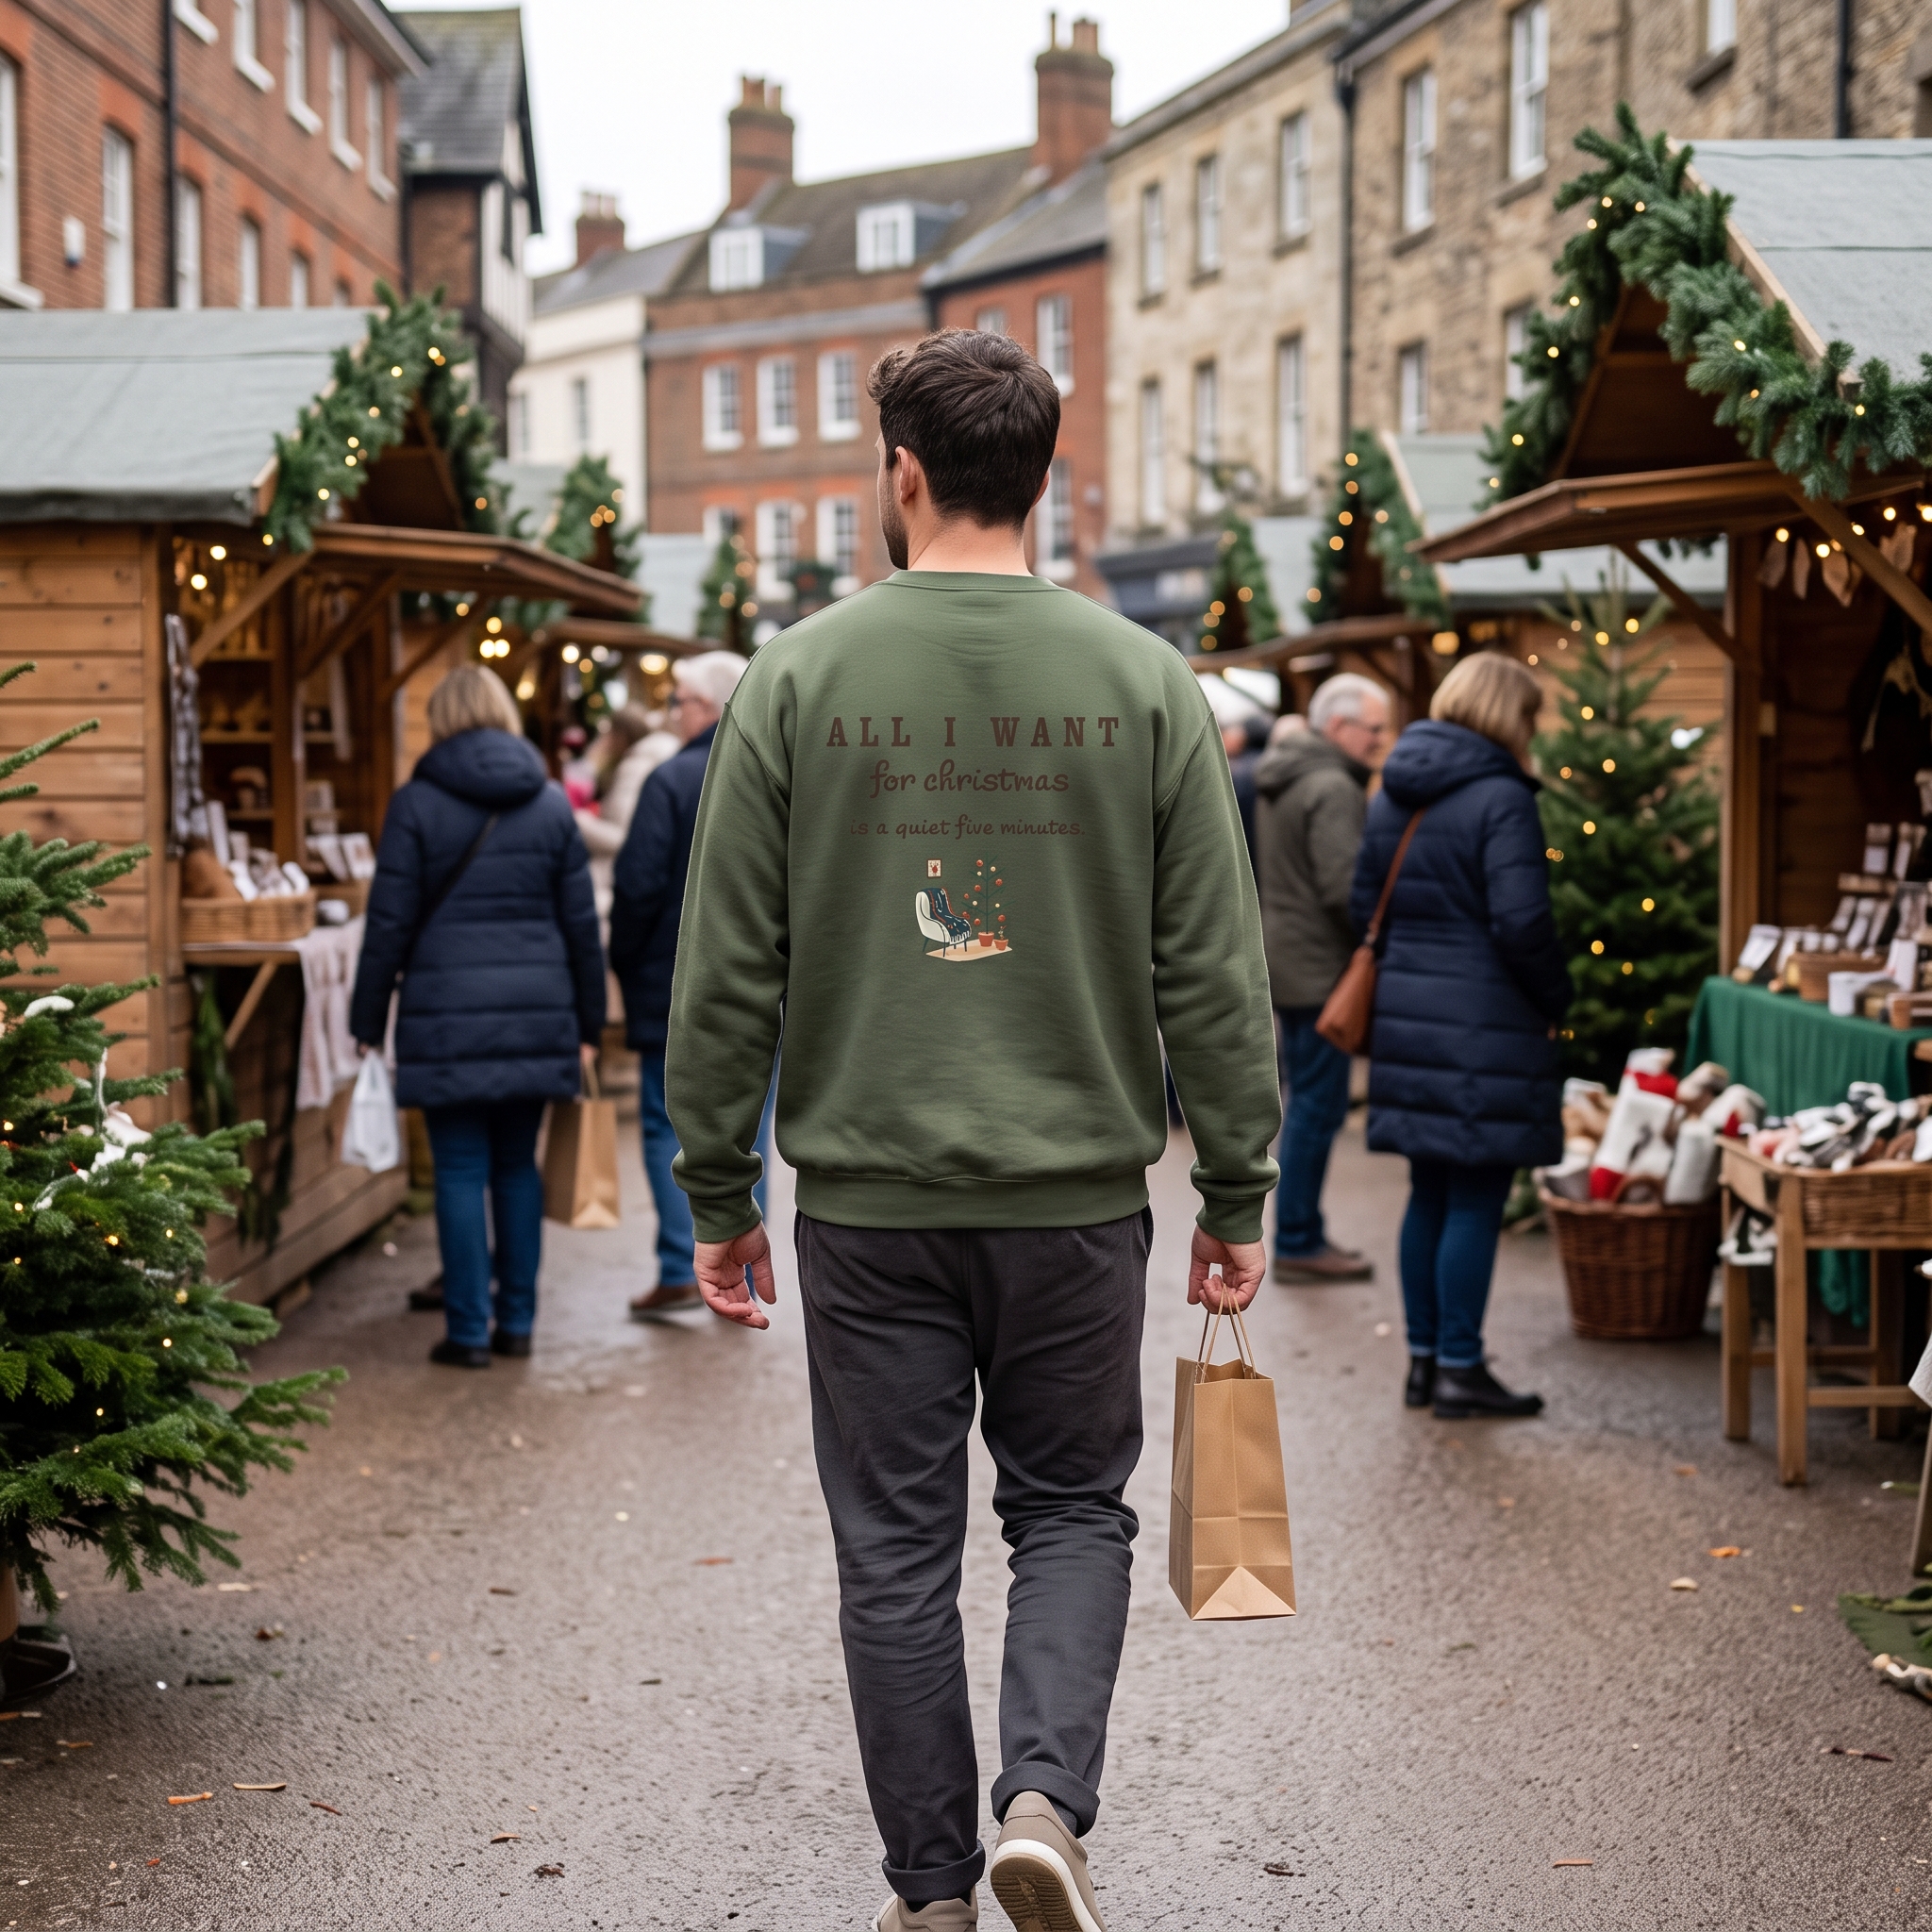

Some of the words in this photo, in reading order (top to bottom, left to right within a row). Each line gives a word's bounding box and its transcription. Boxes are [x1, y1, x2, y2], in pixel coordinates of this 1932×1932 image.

[826, 717, 911, 747] ALL
[944, 717, 957, 747] I
[990, 717, 1119, 747] WANT
[869, 758, 916, 799] for
[923, 758, 1070, 792] christmas
[850, 818, 869, 836] is
[875, 822, 889, 836] a
[894, 818, 951, 840] quiet
[955, 813, 994, 841] five
[1000, 818, 1087, 836] minutes.
